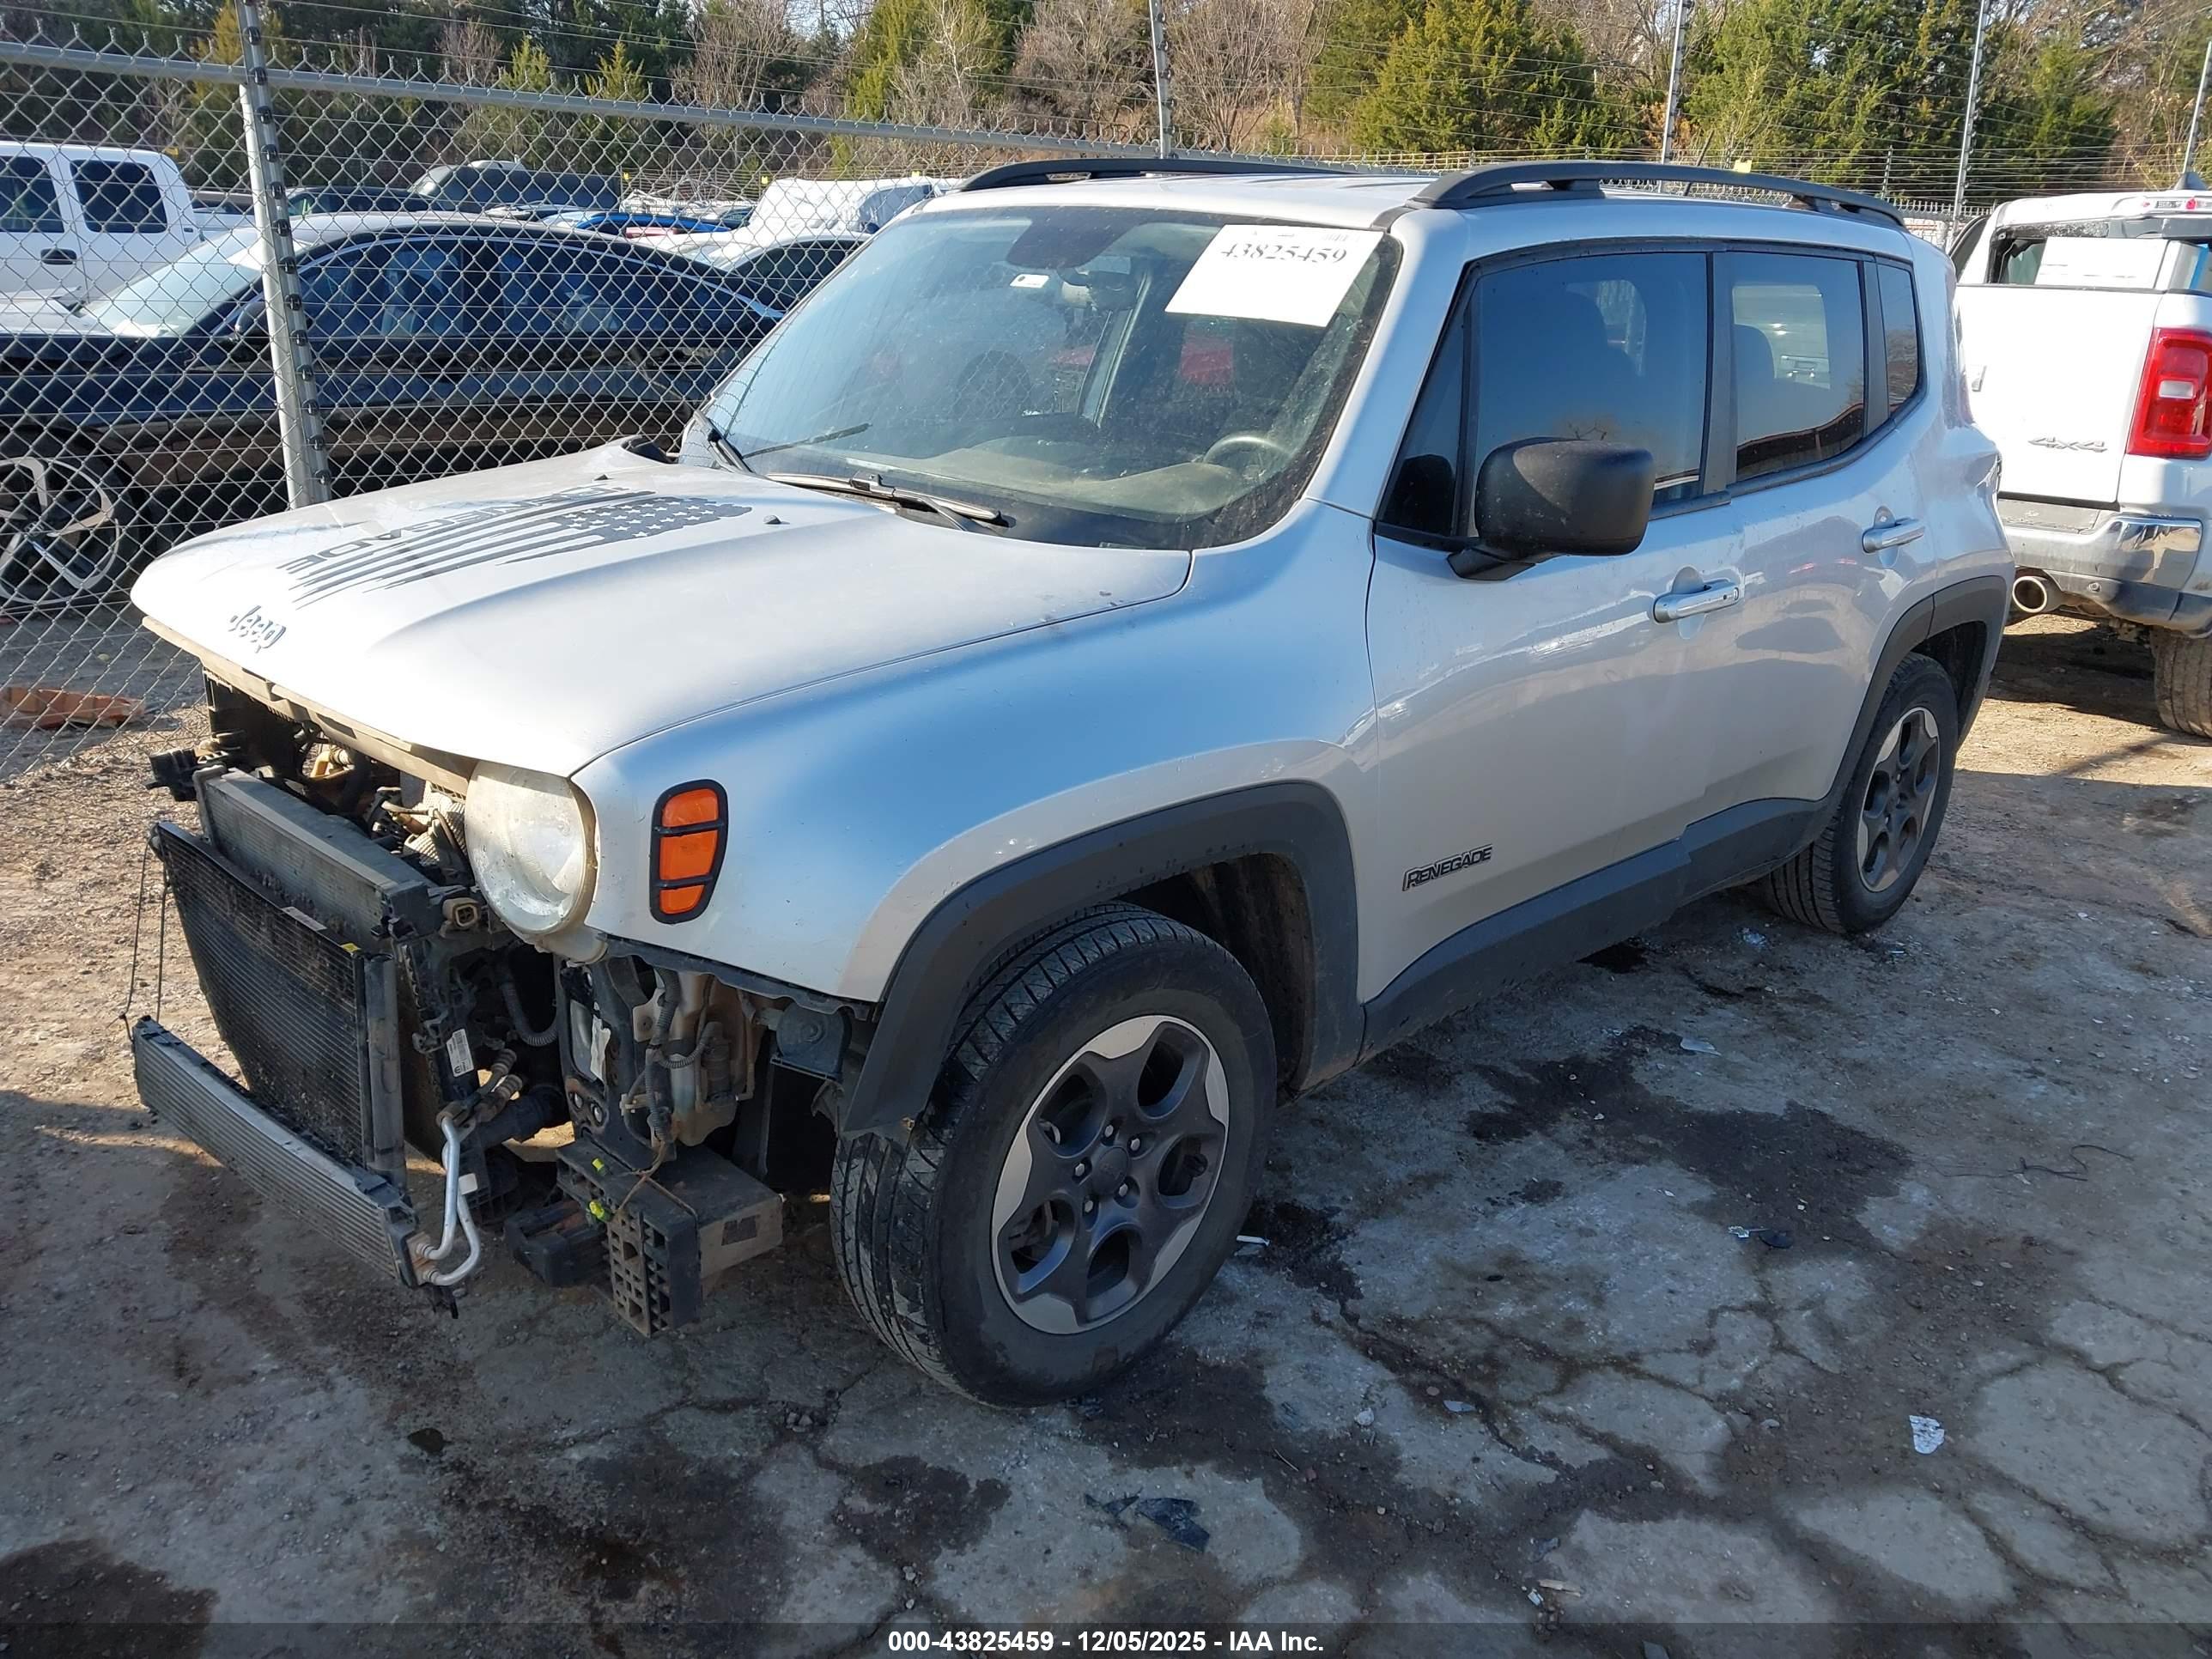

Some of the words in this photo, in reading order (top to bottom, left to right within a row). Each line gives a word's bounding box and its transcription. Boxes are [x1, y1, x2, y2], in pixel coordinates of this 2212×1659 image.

[1220, 243, 1347, 264] 43825459
[228, 605, 287, 654] Jeep
[1401, 843, 1492, 892] RENEGADE
